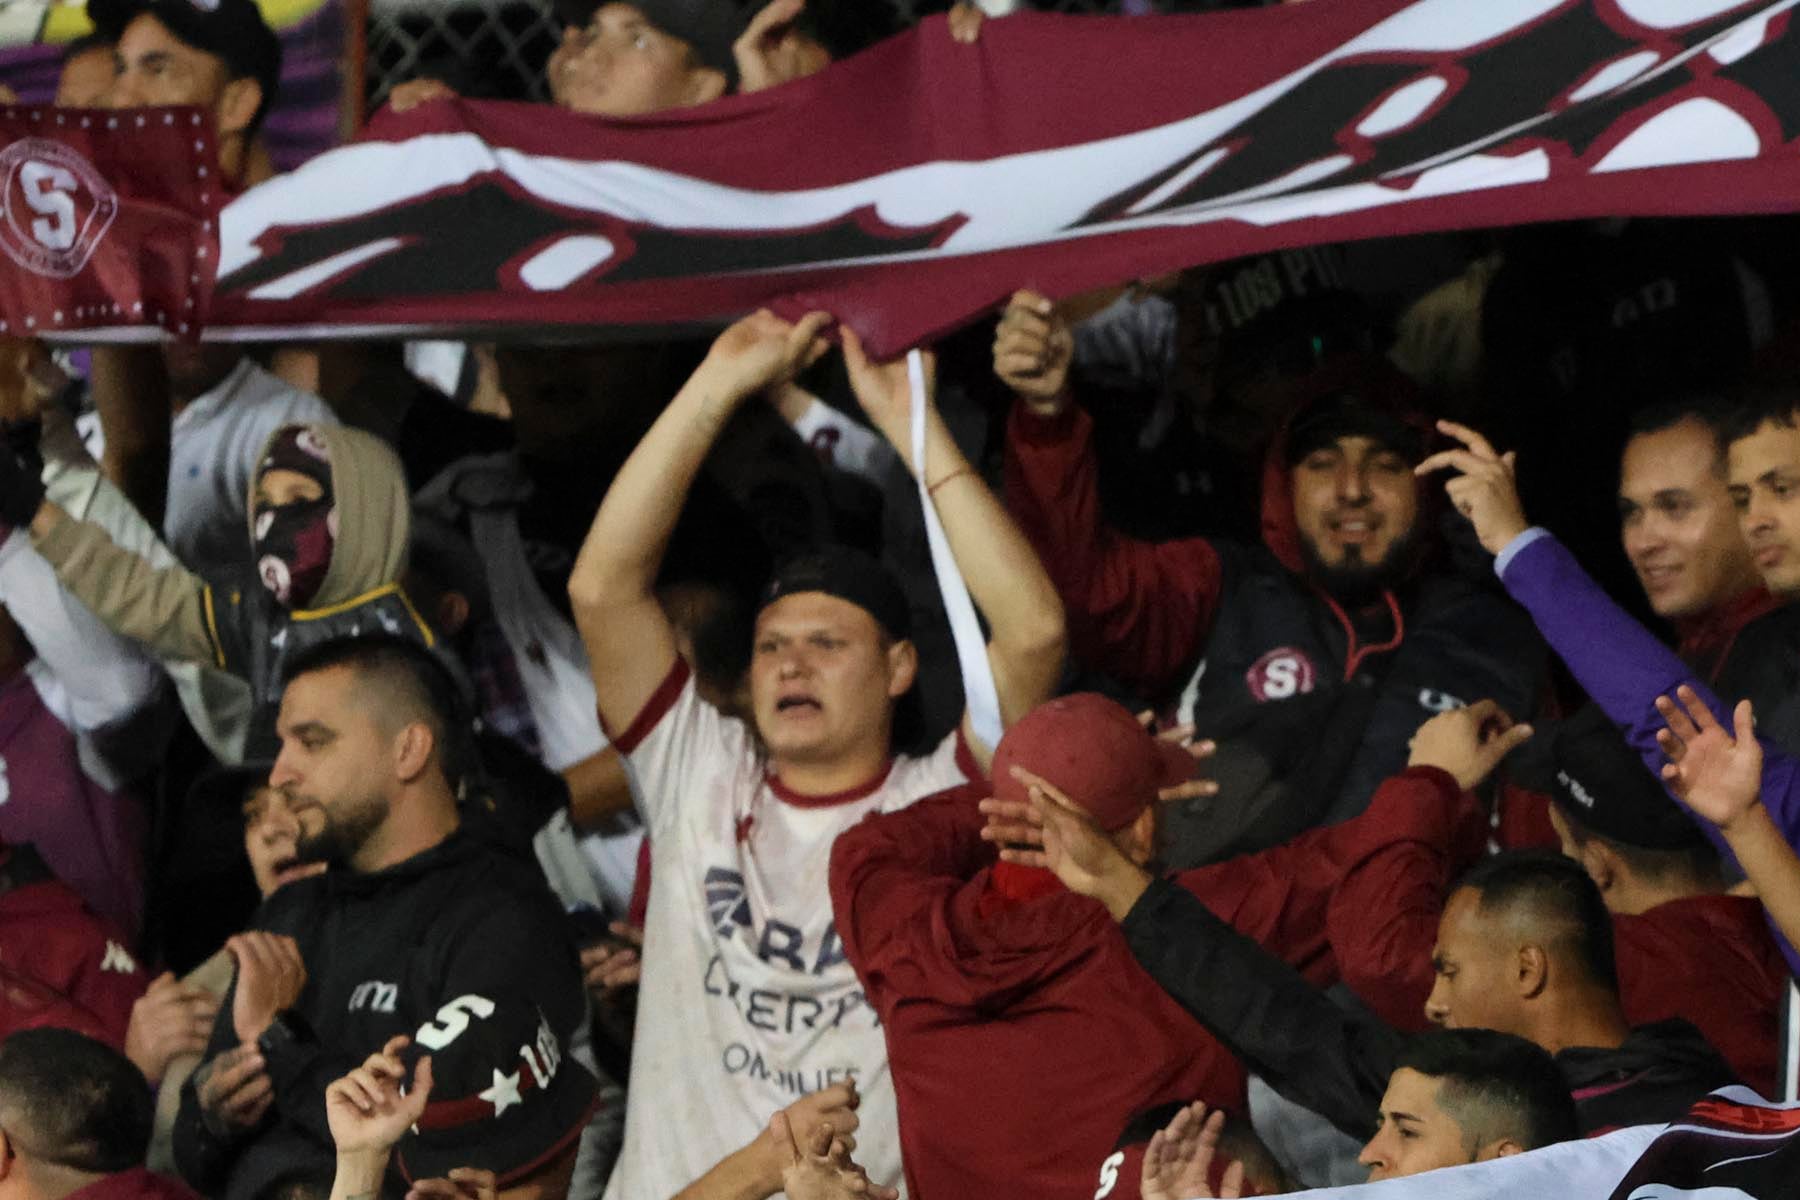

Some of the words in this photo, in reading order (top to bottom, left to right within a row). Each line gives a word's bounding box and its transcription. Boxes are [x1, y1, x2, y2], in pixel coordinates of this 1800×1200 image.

[20, 160, 78, 250] S
[1264, 657, 1298, 699] S
[415, 993, 495, 1050] S
